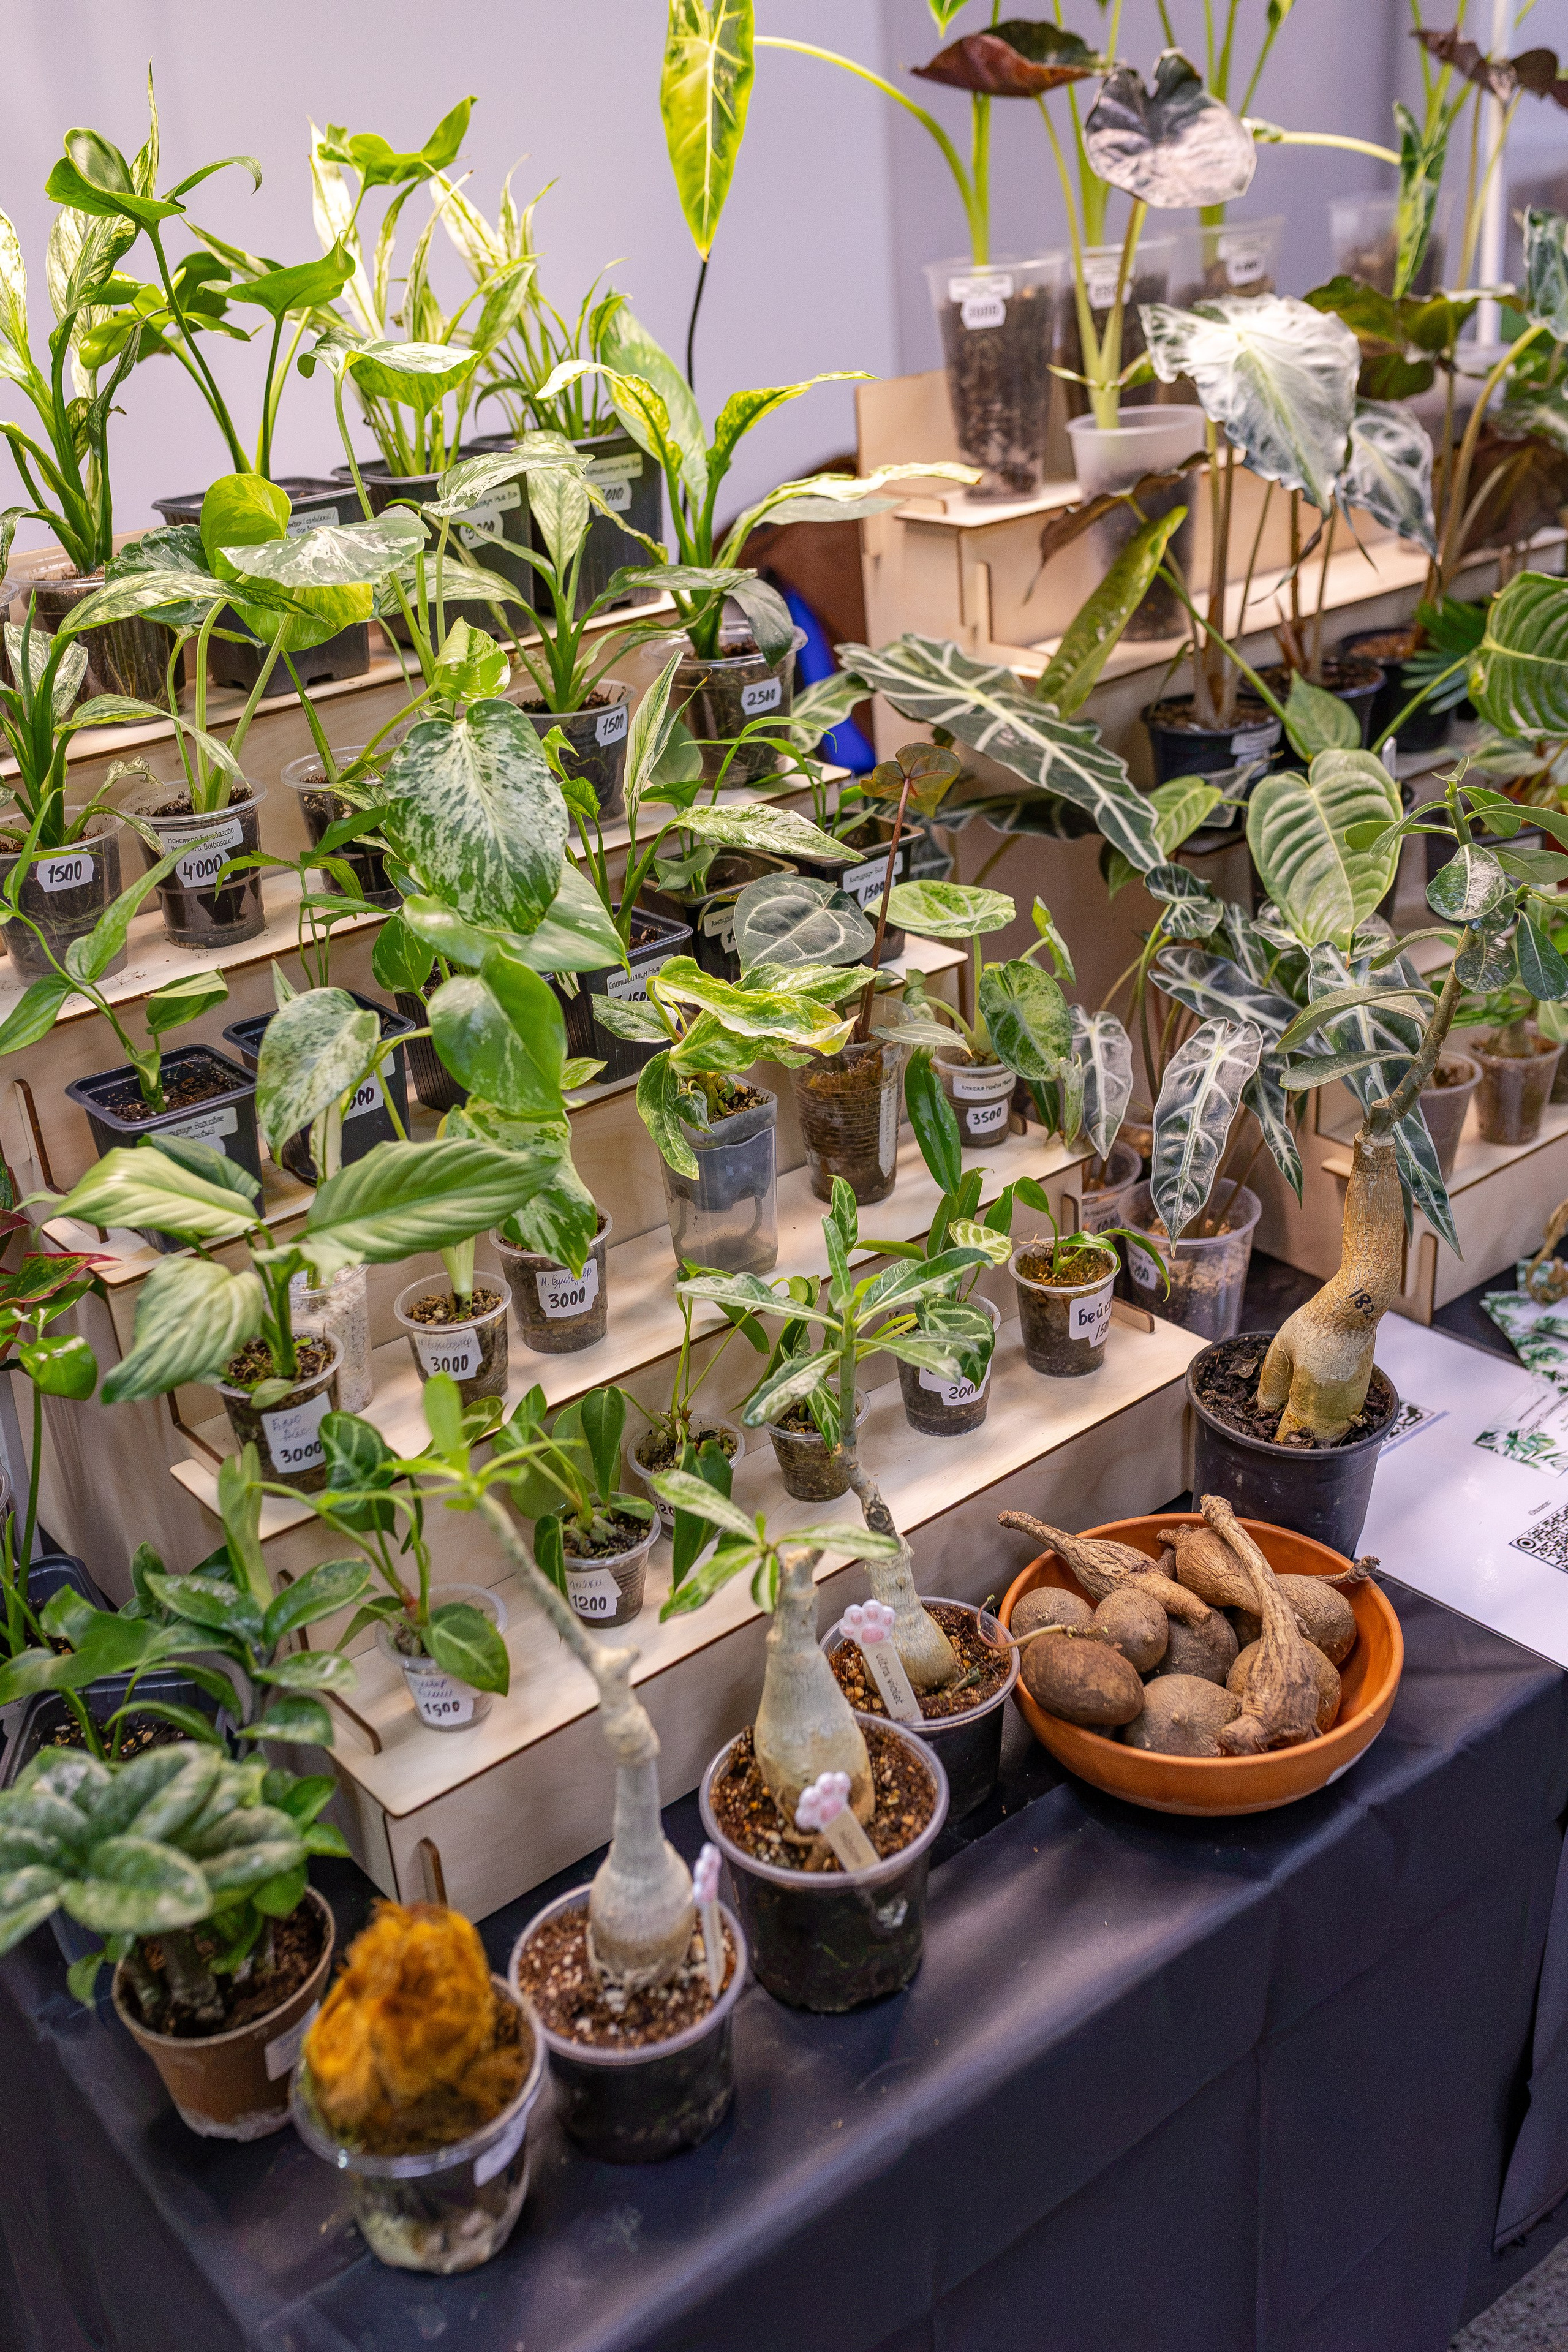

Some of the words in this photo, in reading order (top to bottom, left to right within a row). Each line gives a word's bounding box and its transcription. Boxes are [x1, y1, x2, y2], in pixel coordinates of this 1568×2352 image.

[603, 713, 624, 736] 1500
[204, 836, 234, 850] Bulbasaur)
[48, 860, 82, 883] 1500
[649, 966, 660, 975] Нью
[972, 1107, 1002, 1125] 3500
[548, 1286, 586, 1309] 3000
[1348, 1287, 1374, 1319] 182
[430, 1354, 469, 1373] 3000
[280, 1441, 322, 1463] 3000
[572, 1594, 607, 1611] 1200
[423, 1700, 460, 1717] 1500
